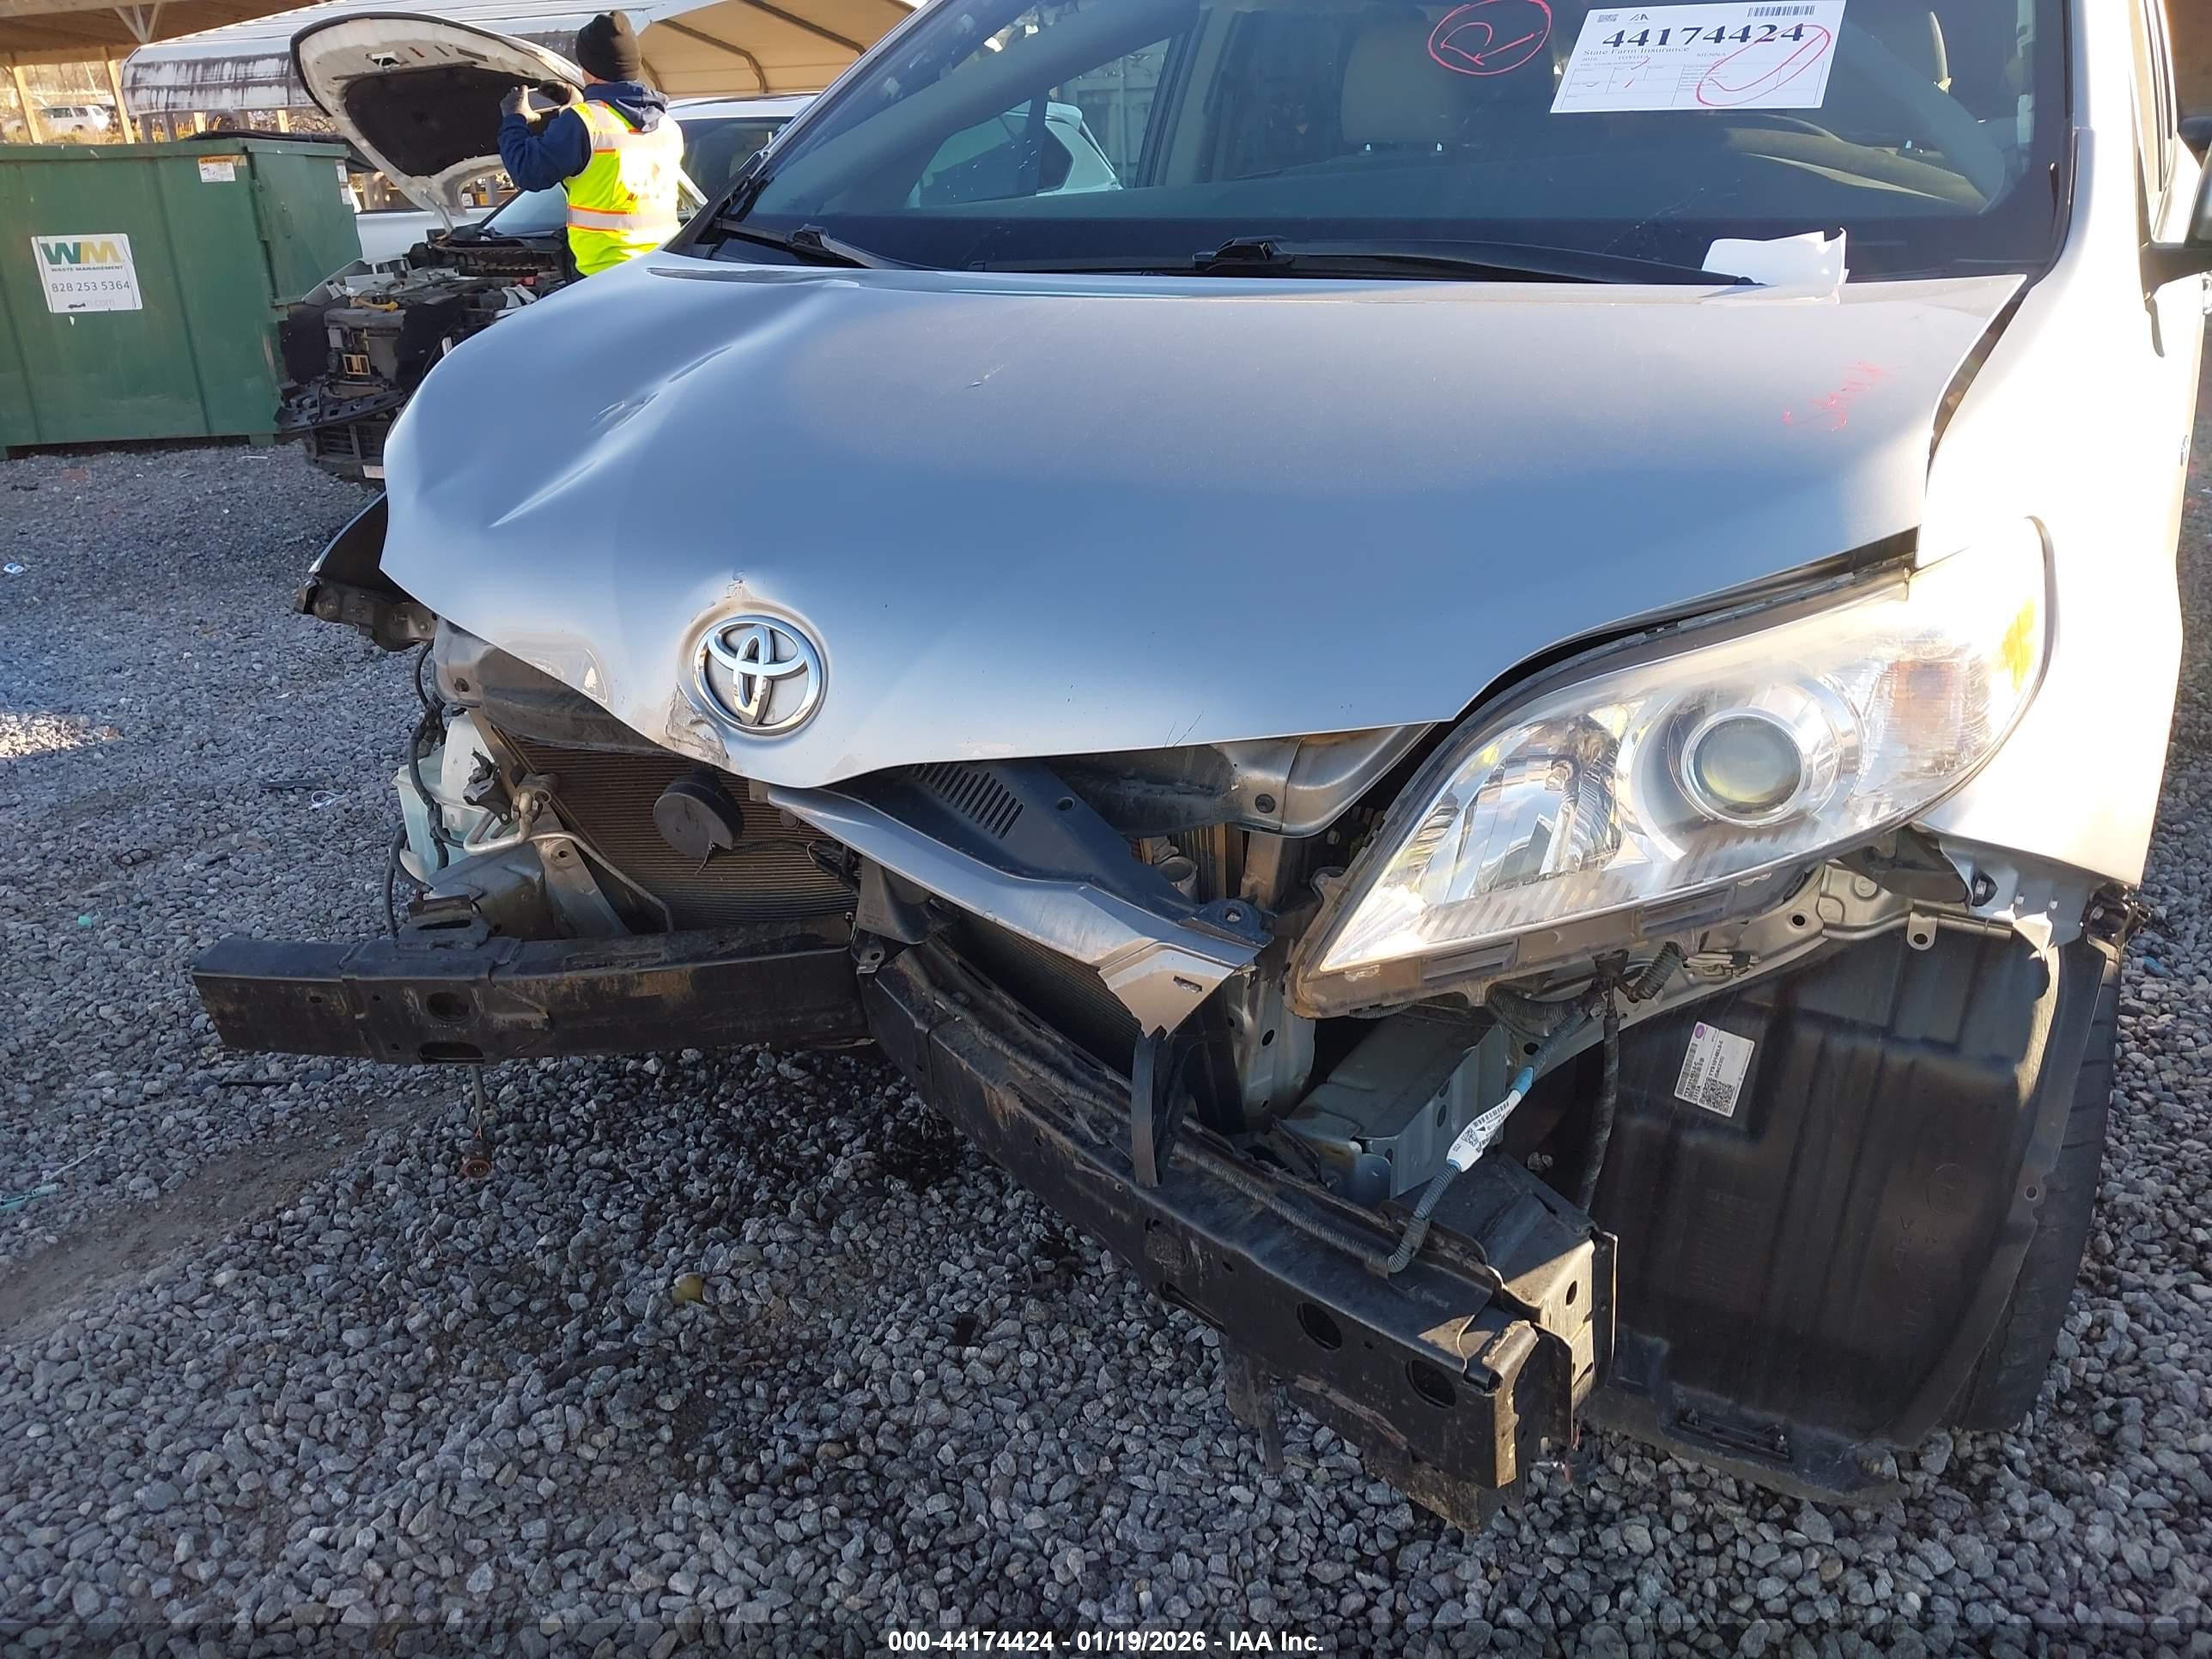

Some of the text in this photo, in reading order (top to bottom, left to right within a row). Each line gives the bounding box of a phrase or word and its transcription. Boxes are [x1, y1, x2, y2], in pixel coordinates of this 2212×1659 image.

[1601, 22, 1804, 48] 44174424
[40, 241, 123, 264] WM
[52, 281, 130, 293] 828 253 5364
